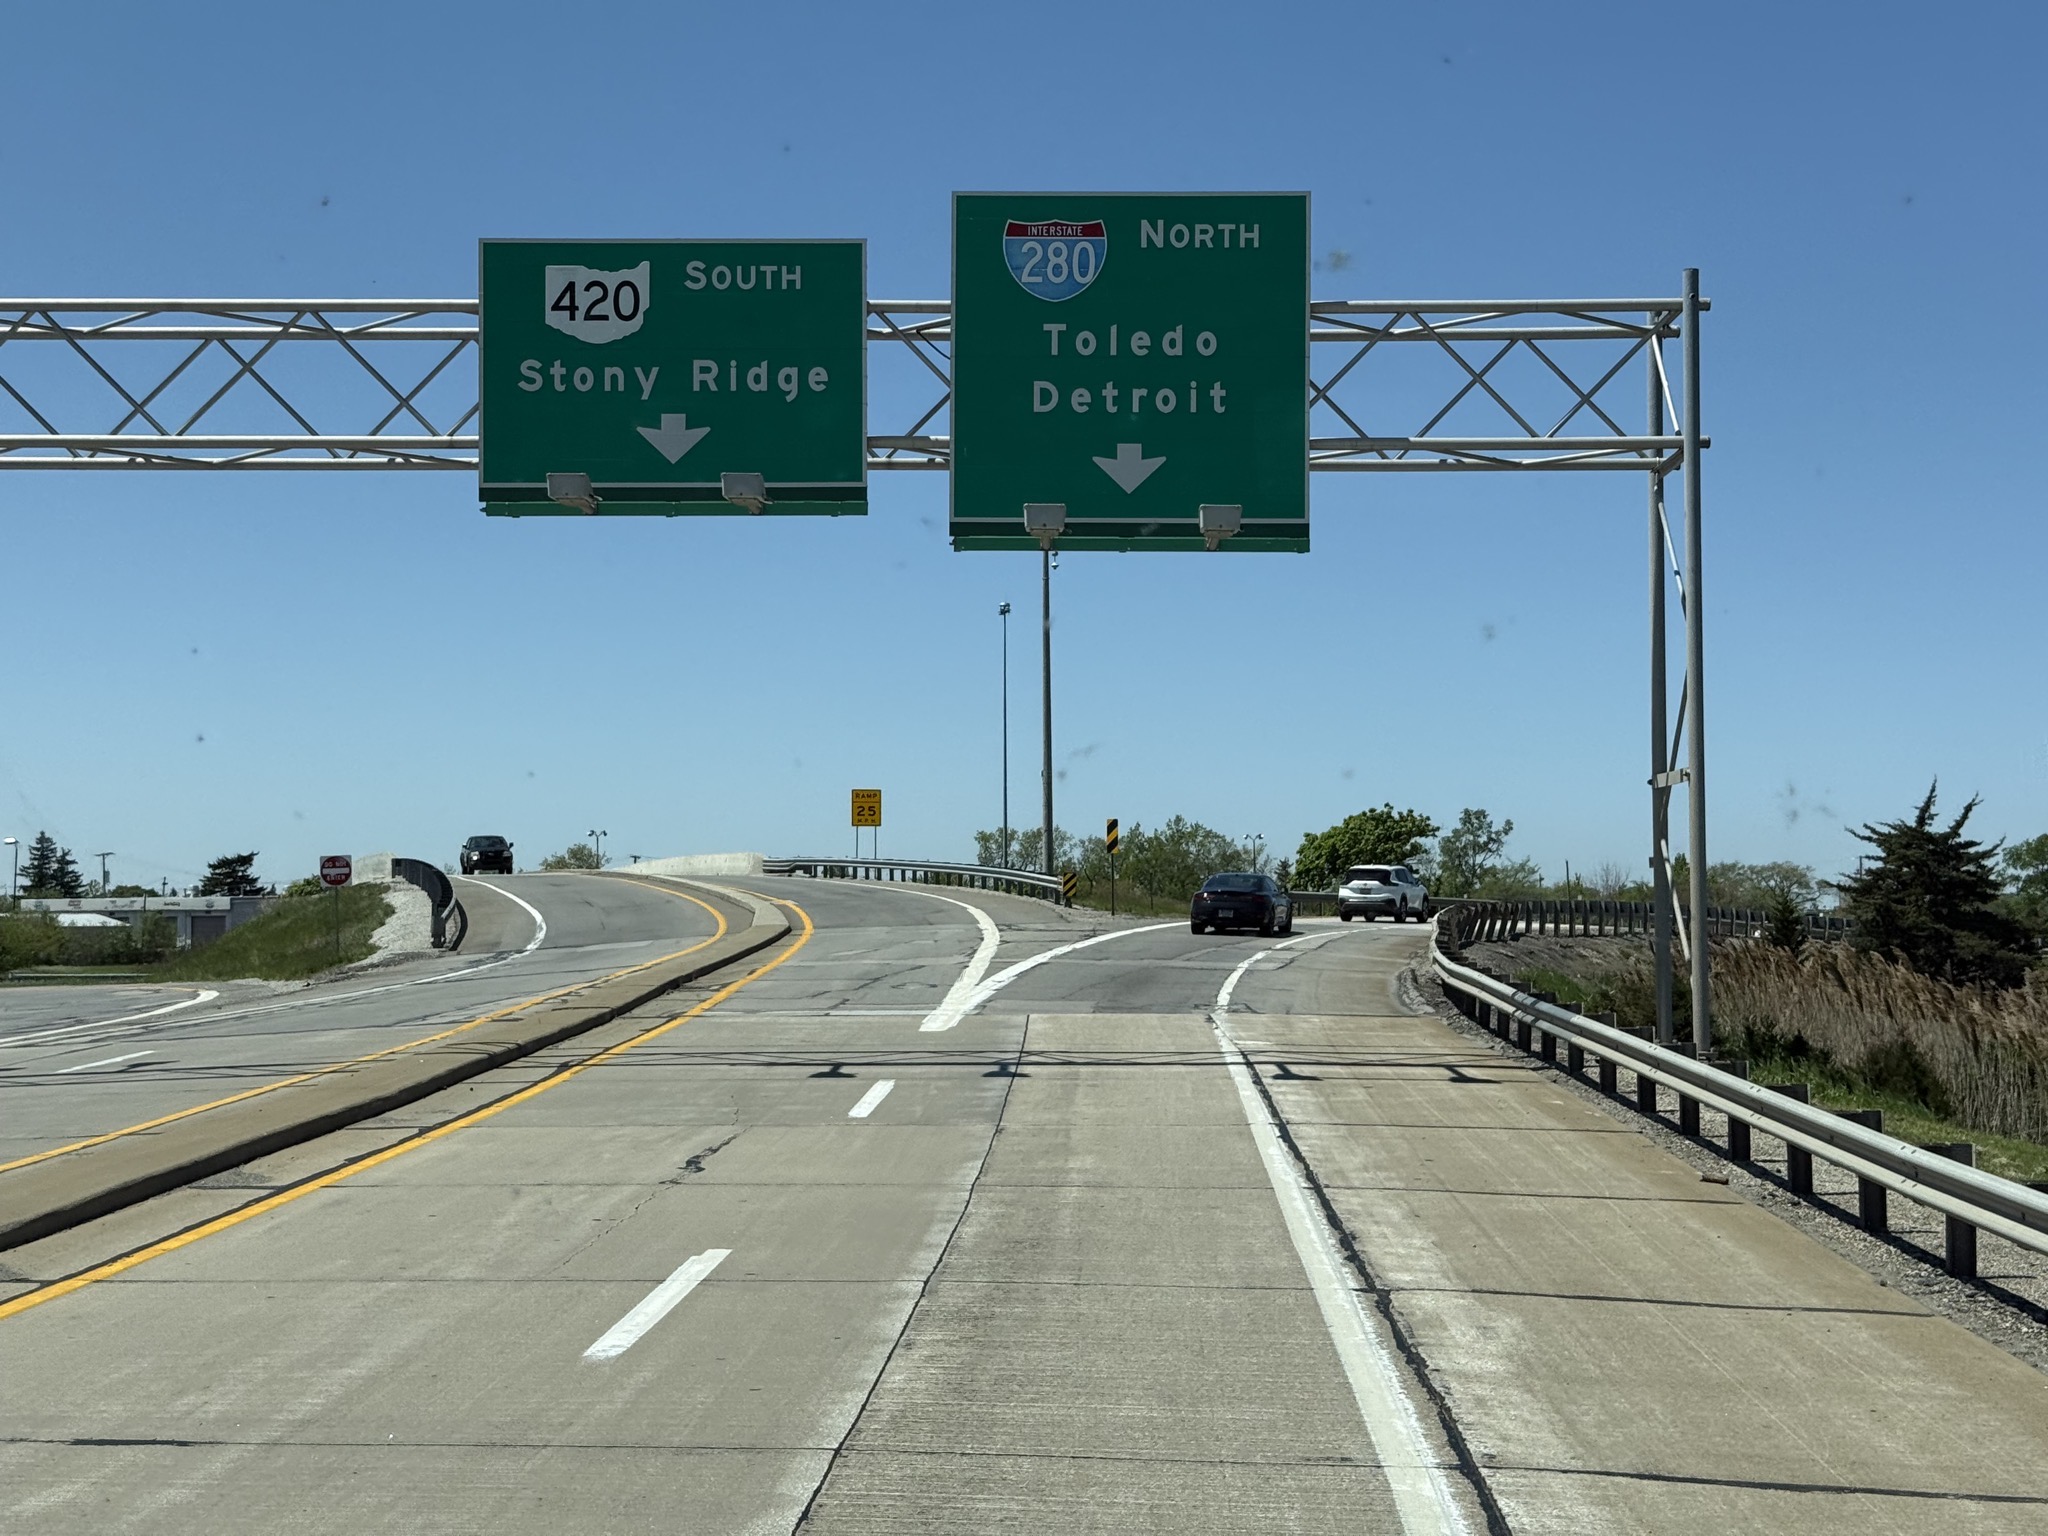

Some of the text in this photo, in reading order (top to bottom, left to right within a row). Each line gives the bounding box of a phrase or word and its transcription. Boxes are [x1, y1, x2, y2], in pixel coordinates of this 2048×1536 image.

[1027, 225, 1083, 237] INTERSTATE
[1140, 219, 1260, 249] NORTH
[683, 260, 802, 291] SOUTH
[1020, 240, 1096, 284] 280
[550, 280, 641, 322] 420
[1043, 323, 1218, 356] Toledo
[517, 358, 829, 403] Stony Ridge
[1033, 380, 1227, 414] Detroit
[857, 806, 876, 816] 25
